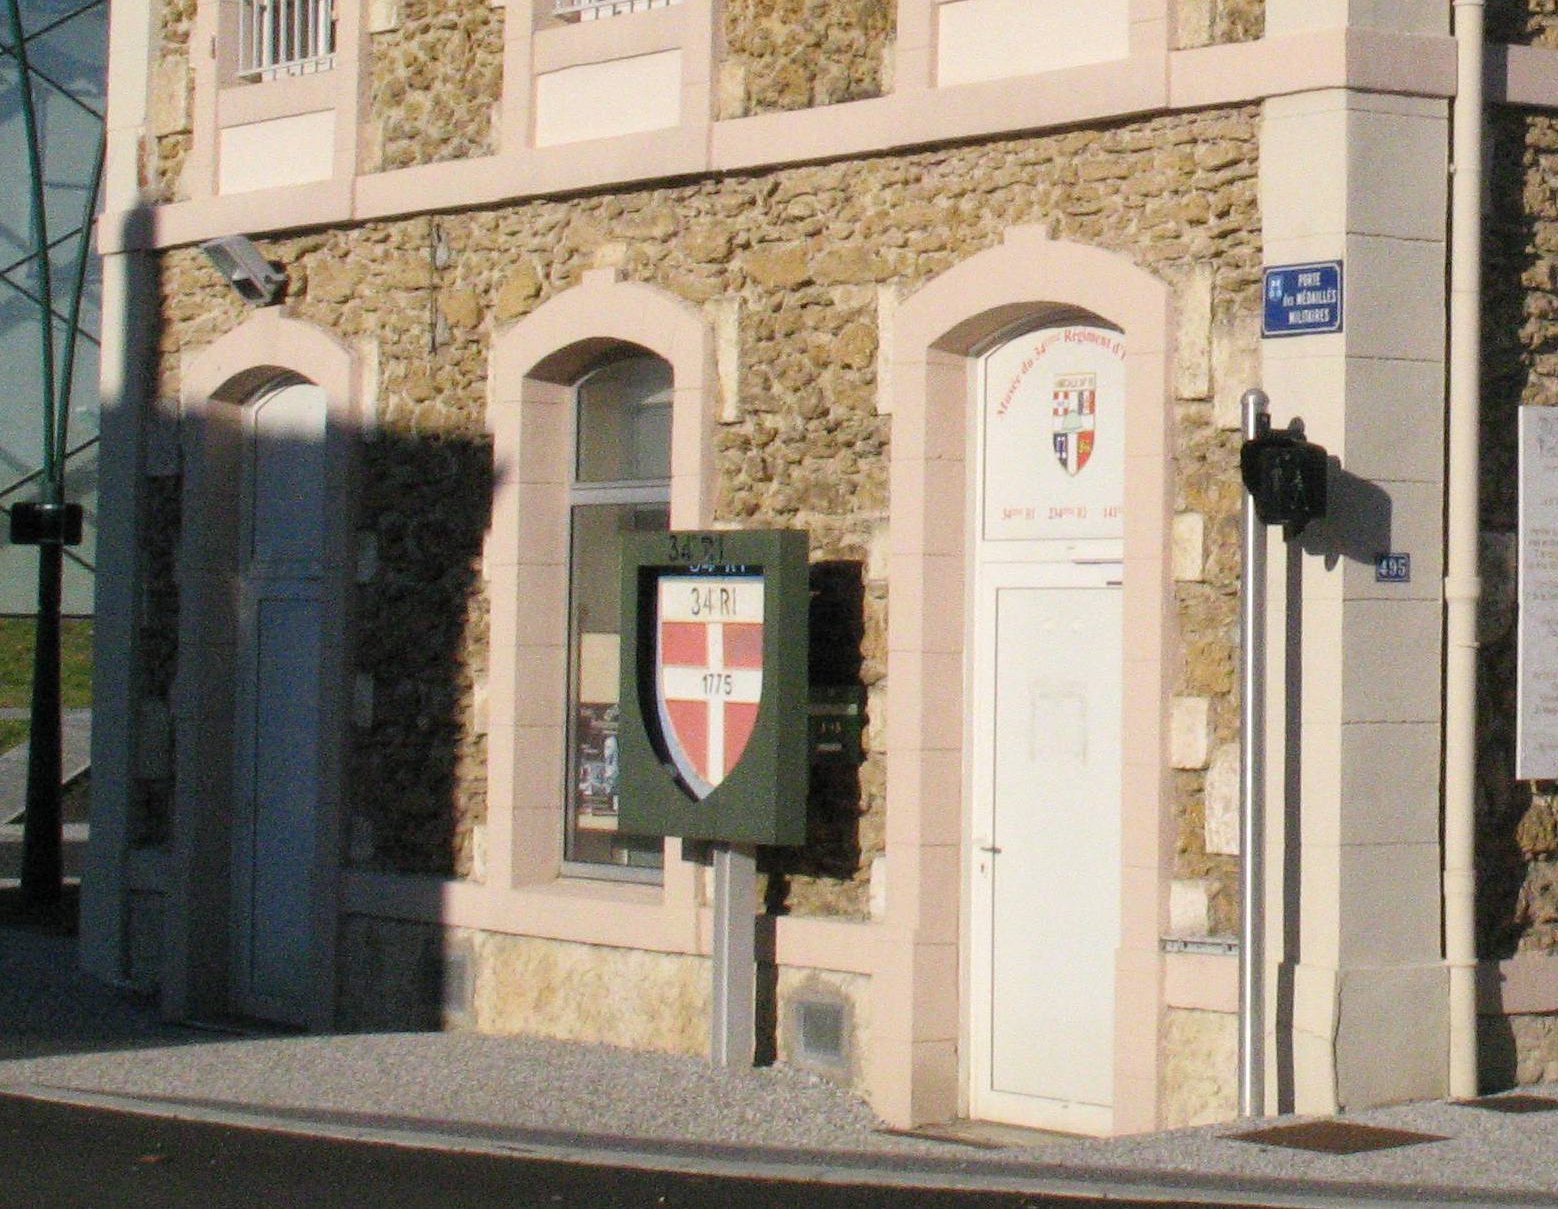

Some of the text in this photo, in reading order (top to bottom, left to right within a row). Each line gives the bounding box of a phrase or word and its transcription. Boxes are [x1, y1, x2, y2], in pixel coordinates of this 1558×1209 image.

[1298, 272, 1321, 287] PORTE
[1288, 307, 1330, 325] MILITAIRES
[1064, 329, 1112, 349] Régiment
[1379, 557, 1406, 576] 495
[720, 587, 737, 616] RI
[702, 672, 733, 696] 1775
